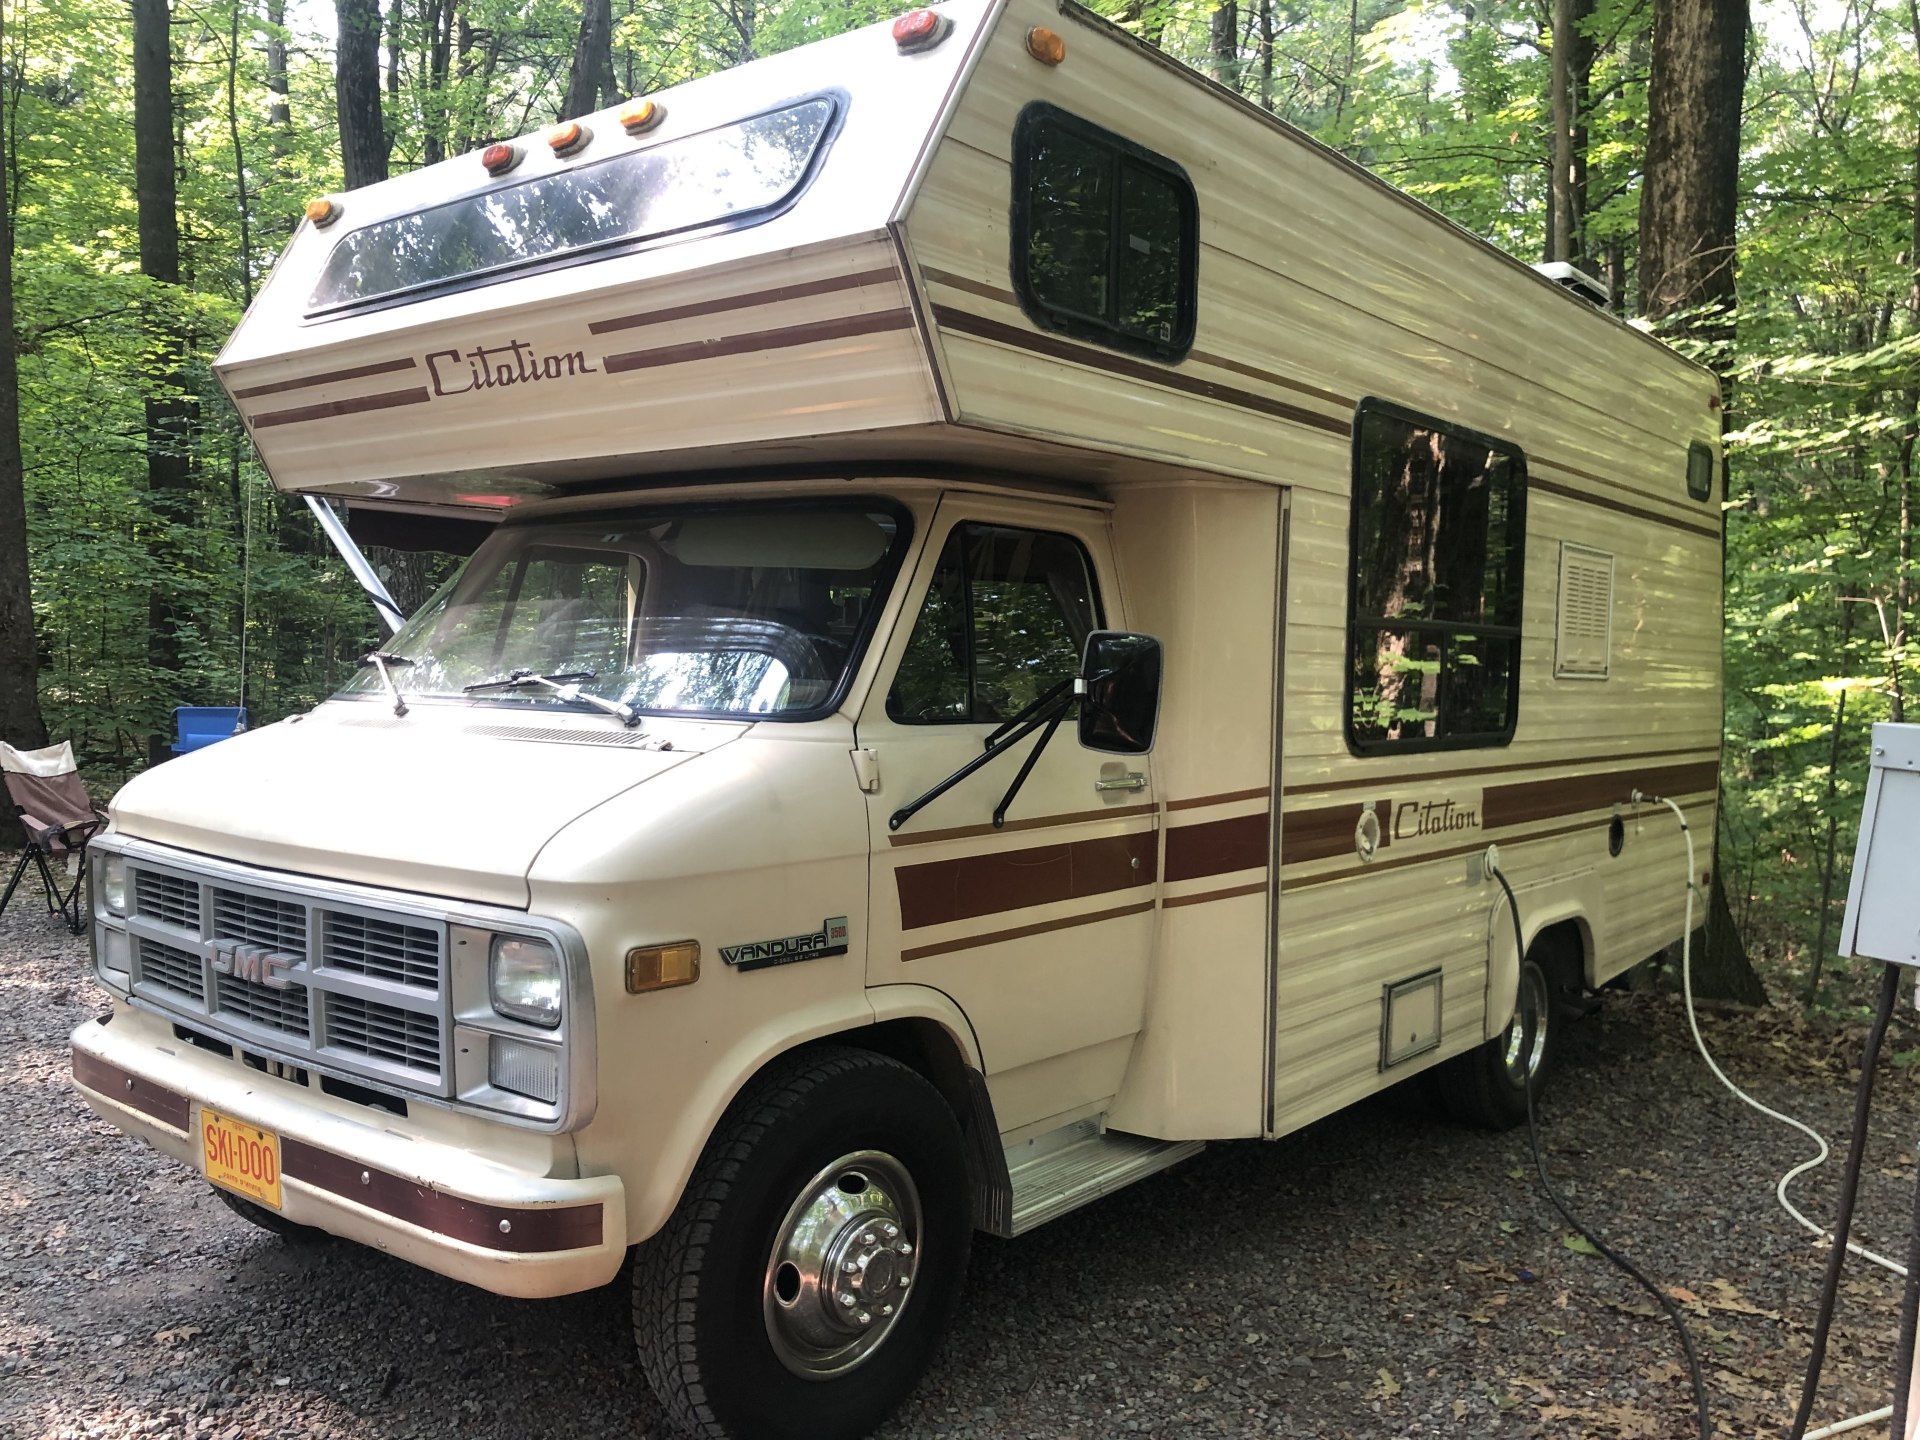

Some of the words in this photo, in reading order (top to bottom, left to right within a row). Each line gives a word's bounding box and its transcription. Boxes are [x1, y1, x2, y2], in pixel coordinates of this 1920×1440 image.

[425, 339, 597, 396] Citation
[1394, 799, 1479, 840] Citation
[206, 938, 302, 990] GMC
[721, 933, 828, 964] VANDURA
[206, 1124, 275, 1185] SKI-DOO
